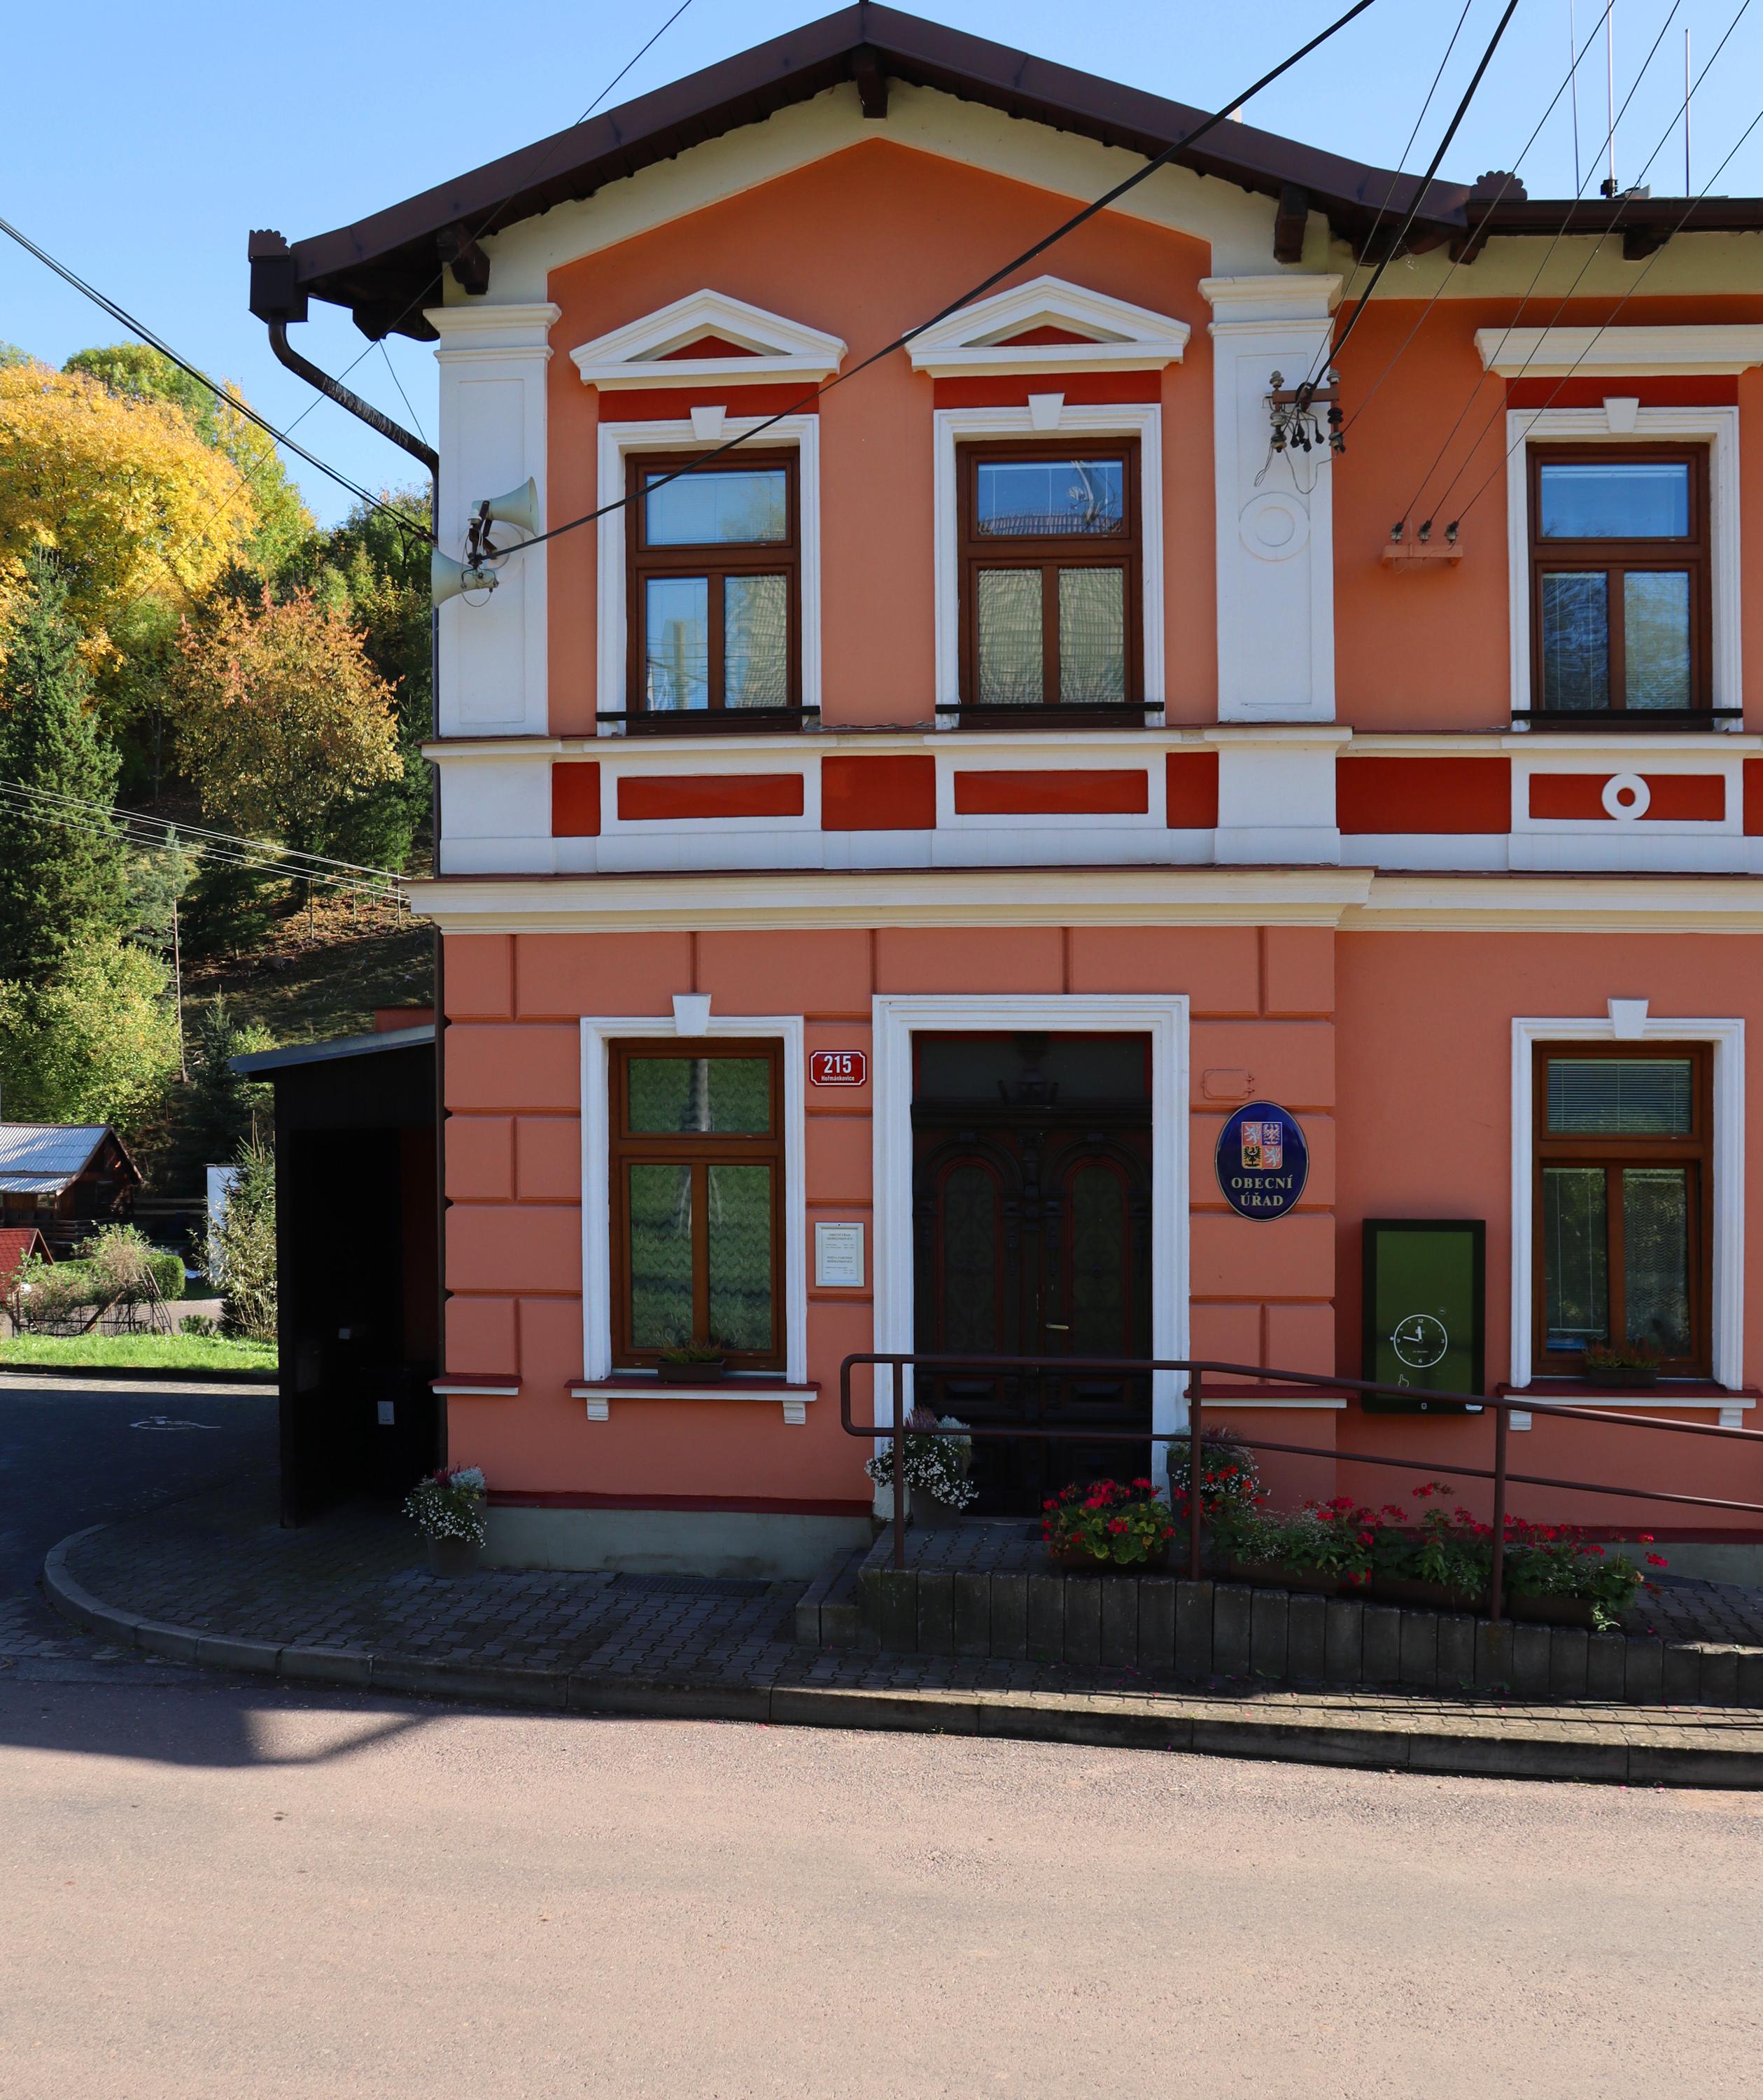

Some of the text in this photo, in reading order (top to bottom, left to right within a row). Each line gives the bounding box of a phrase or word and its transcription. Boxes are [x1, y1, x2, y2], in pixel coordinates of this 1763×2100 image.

[824, 1055, 851, 1073] 215
[1231, 1175, 1293, 1188] OBECNÍ
[1240, 1191, 1283, 1205] ÚŘAD
